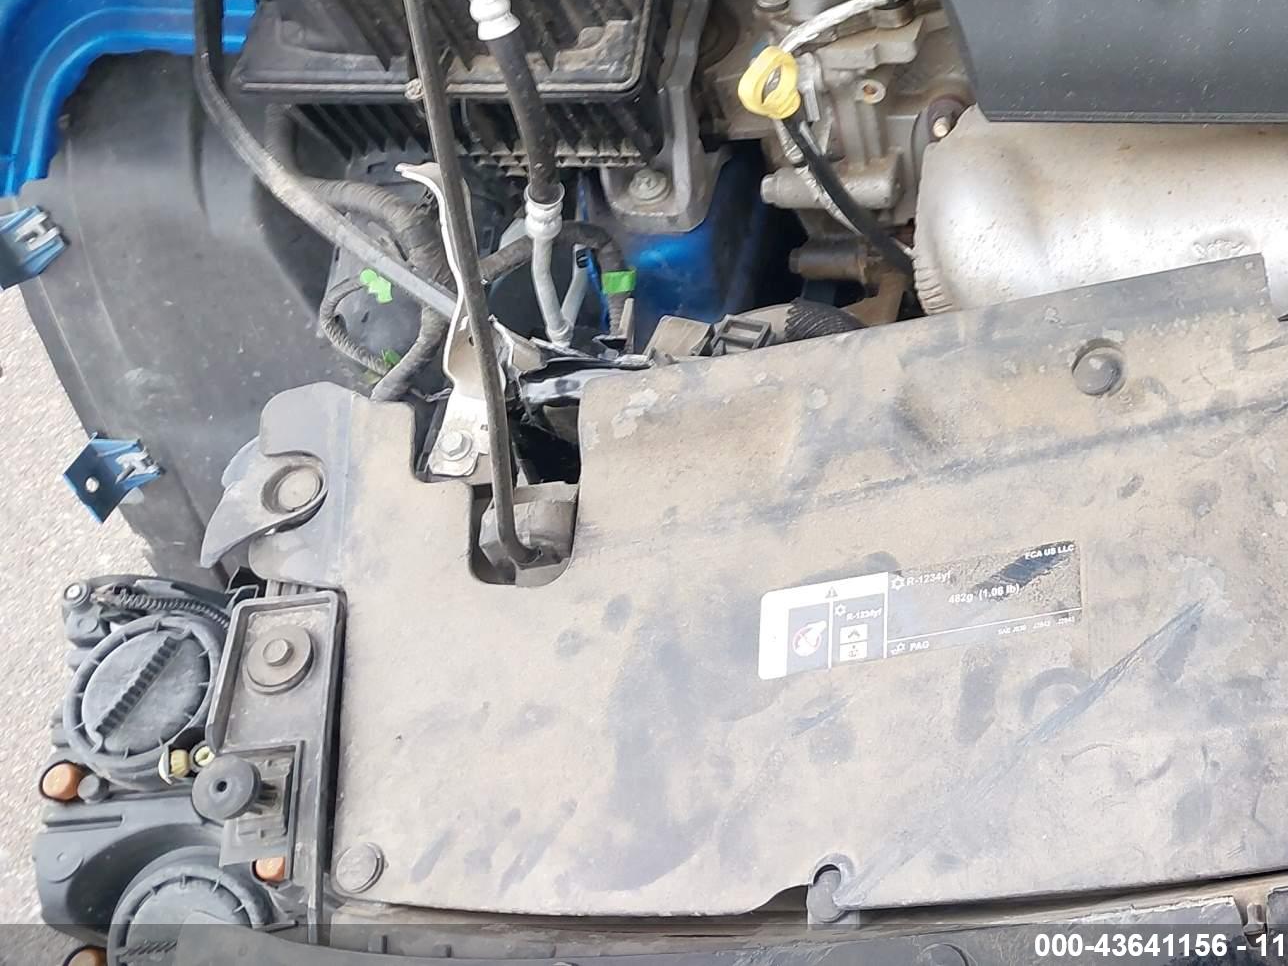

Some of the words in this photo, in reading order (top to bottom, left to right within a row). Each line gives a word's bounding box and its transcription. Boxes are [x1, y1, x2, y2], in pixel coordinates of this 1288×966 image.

[1043, 547, 1056, 556] US
[1057, 544, 1075, 554] LLC
[906, 570, 952, 586] R-1234yf
[948, 593, 973, 604] 482g
[1005, 583, 1019, 595] lb)
[910, 640, 930, 651] PAG
